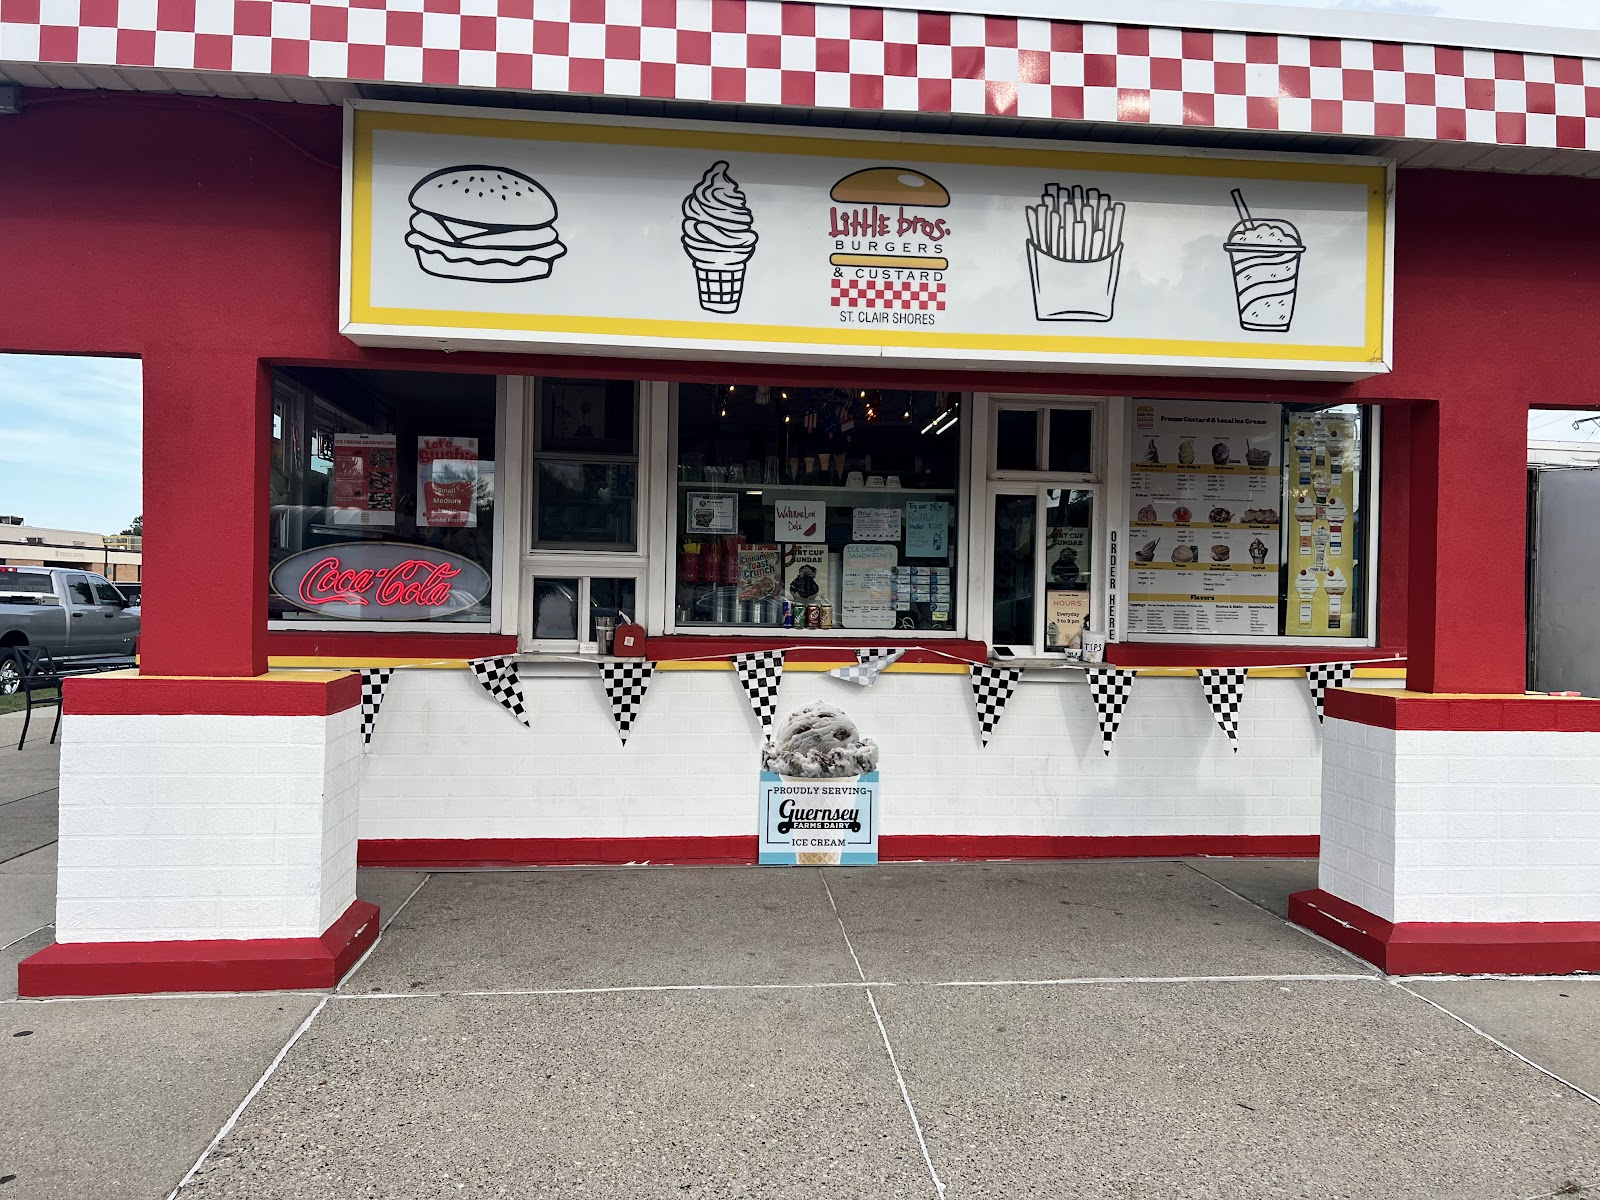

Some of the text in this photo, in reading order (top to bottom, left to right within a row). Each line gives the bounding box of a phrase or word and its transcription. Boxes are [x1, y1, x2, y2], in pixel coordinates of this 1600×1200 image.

[829, 205, 951, 241] Little bros.
[835, 240, 943, 254] BURGERS
[833, 266, 943, 281] & CUSTARD
[840, 310, 935, 325] ST. CLAIR SHORES
[1109, 530, 1117, 589] ORDER
[299, 557, 462, 606] Coca-Cola
[1083, 642, 1102, 652] TIPS
[773, 786, 867, 796] PROUDLY SERVING
[778, 799, 860, 823] Guernsey
[791, 838, 847, 847] ICE CREAM
